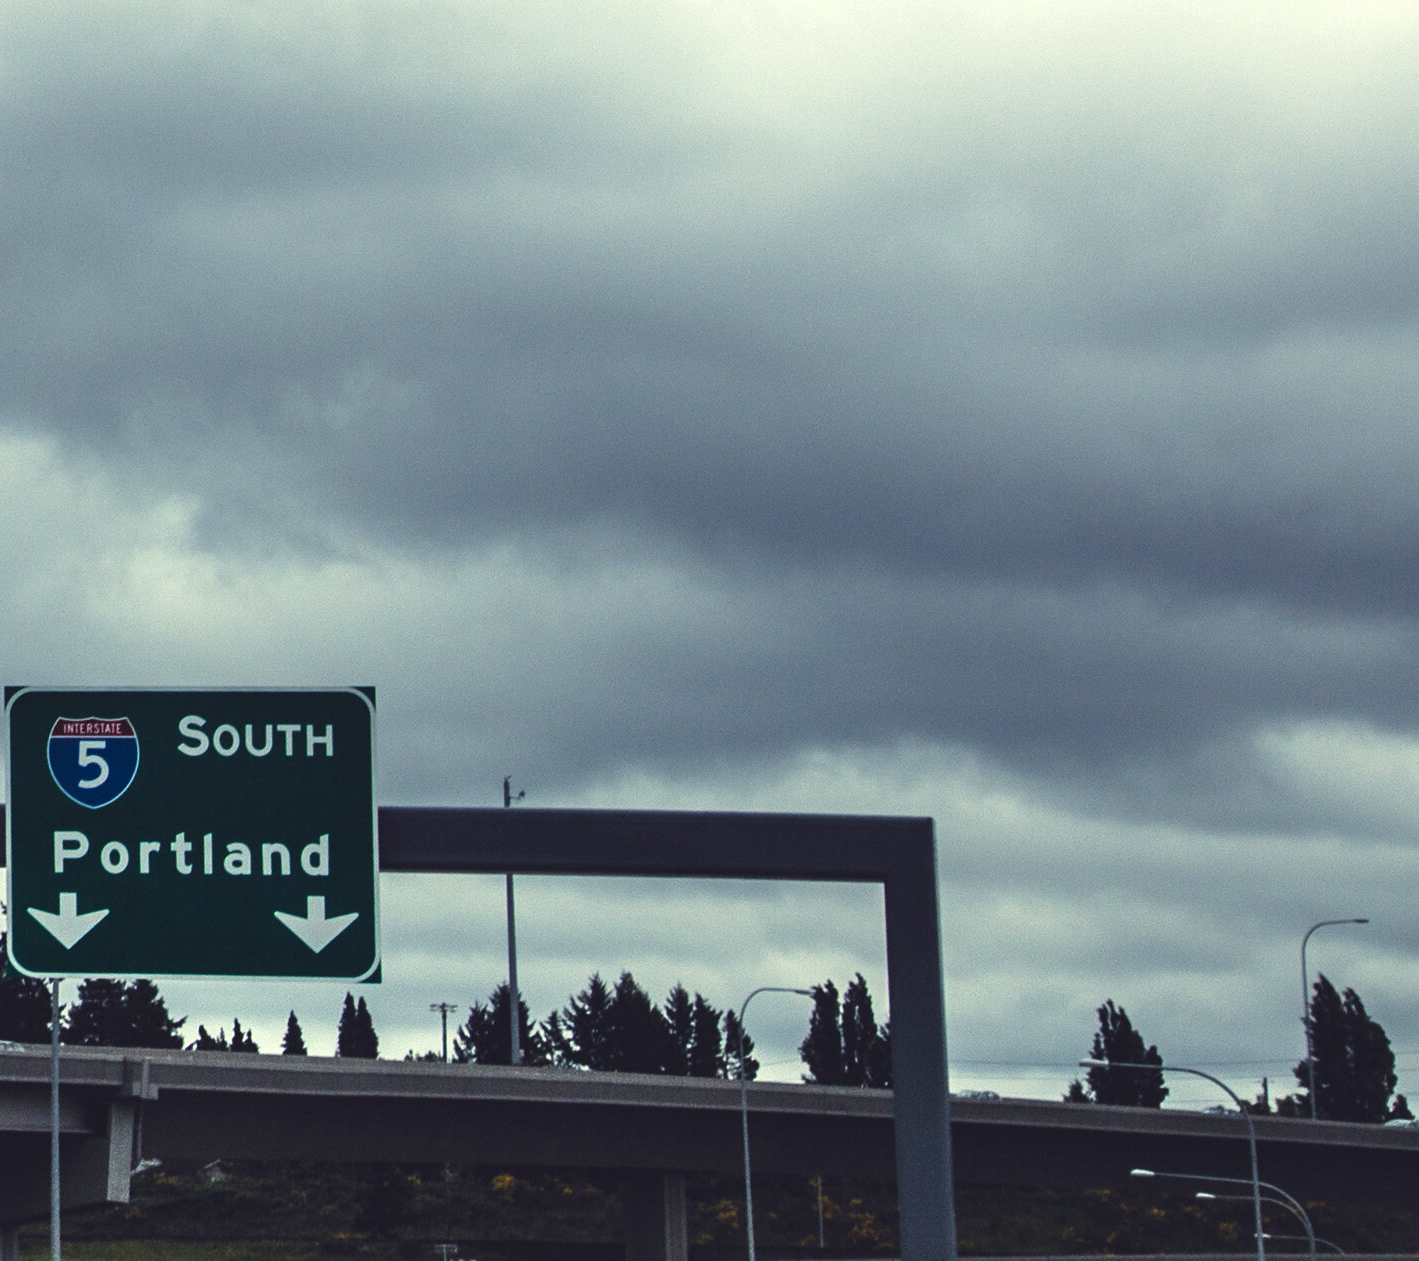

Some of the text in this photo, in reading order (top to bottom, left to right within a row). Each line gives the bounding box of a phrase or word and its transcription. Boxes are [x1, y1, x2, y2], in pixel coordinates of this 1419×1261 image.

[63, 722, 122, 735] INTERSTATE
[78, 740, 109, 789] 5
[53, 830, 330, 876] Portland
